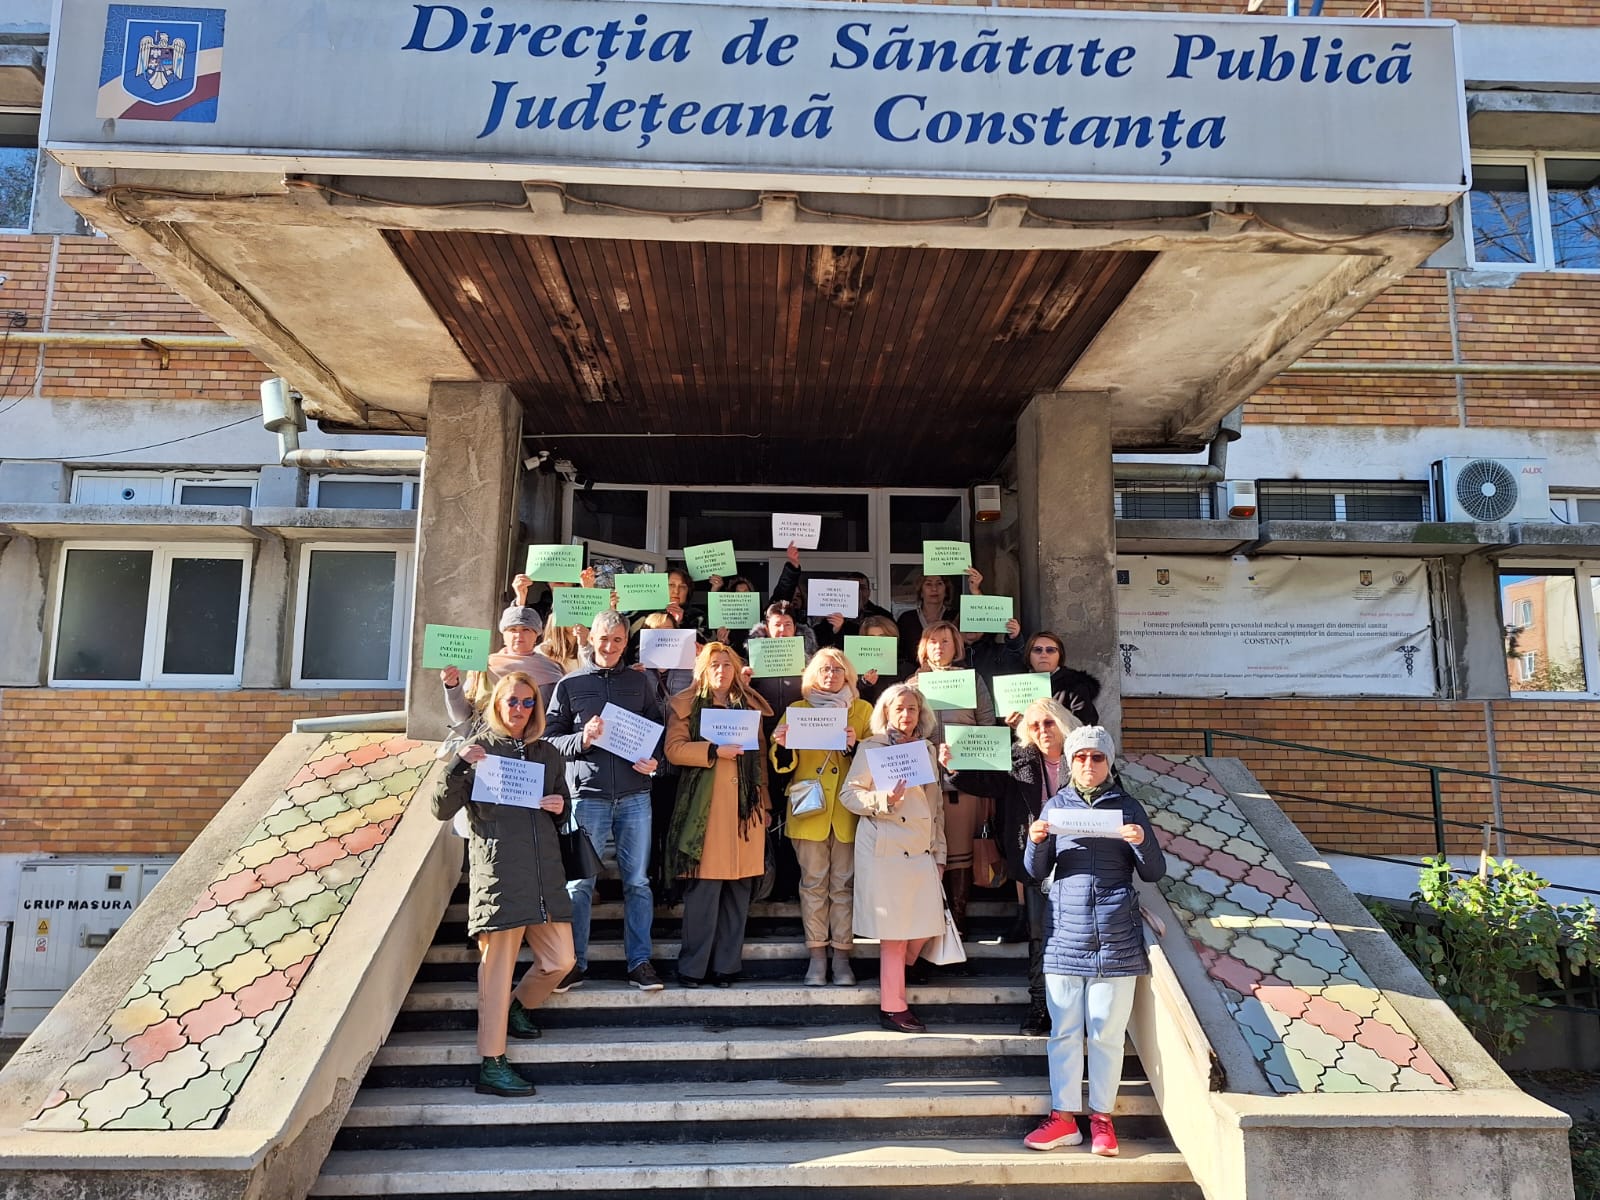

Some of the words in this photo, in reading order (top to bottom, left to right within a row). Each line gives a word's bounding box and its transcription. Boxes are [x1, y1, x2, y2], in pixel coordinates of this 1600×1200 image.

[401, 4, 692, 77] Direcția
[721, 17, 798, 67] de
[873, 94, 1226, 166] Constanța
[68, 900, 132, 911] MASURA
